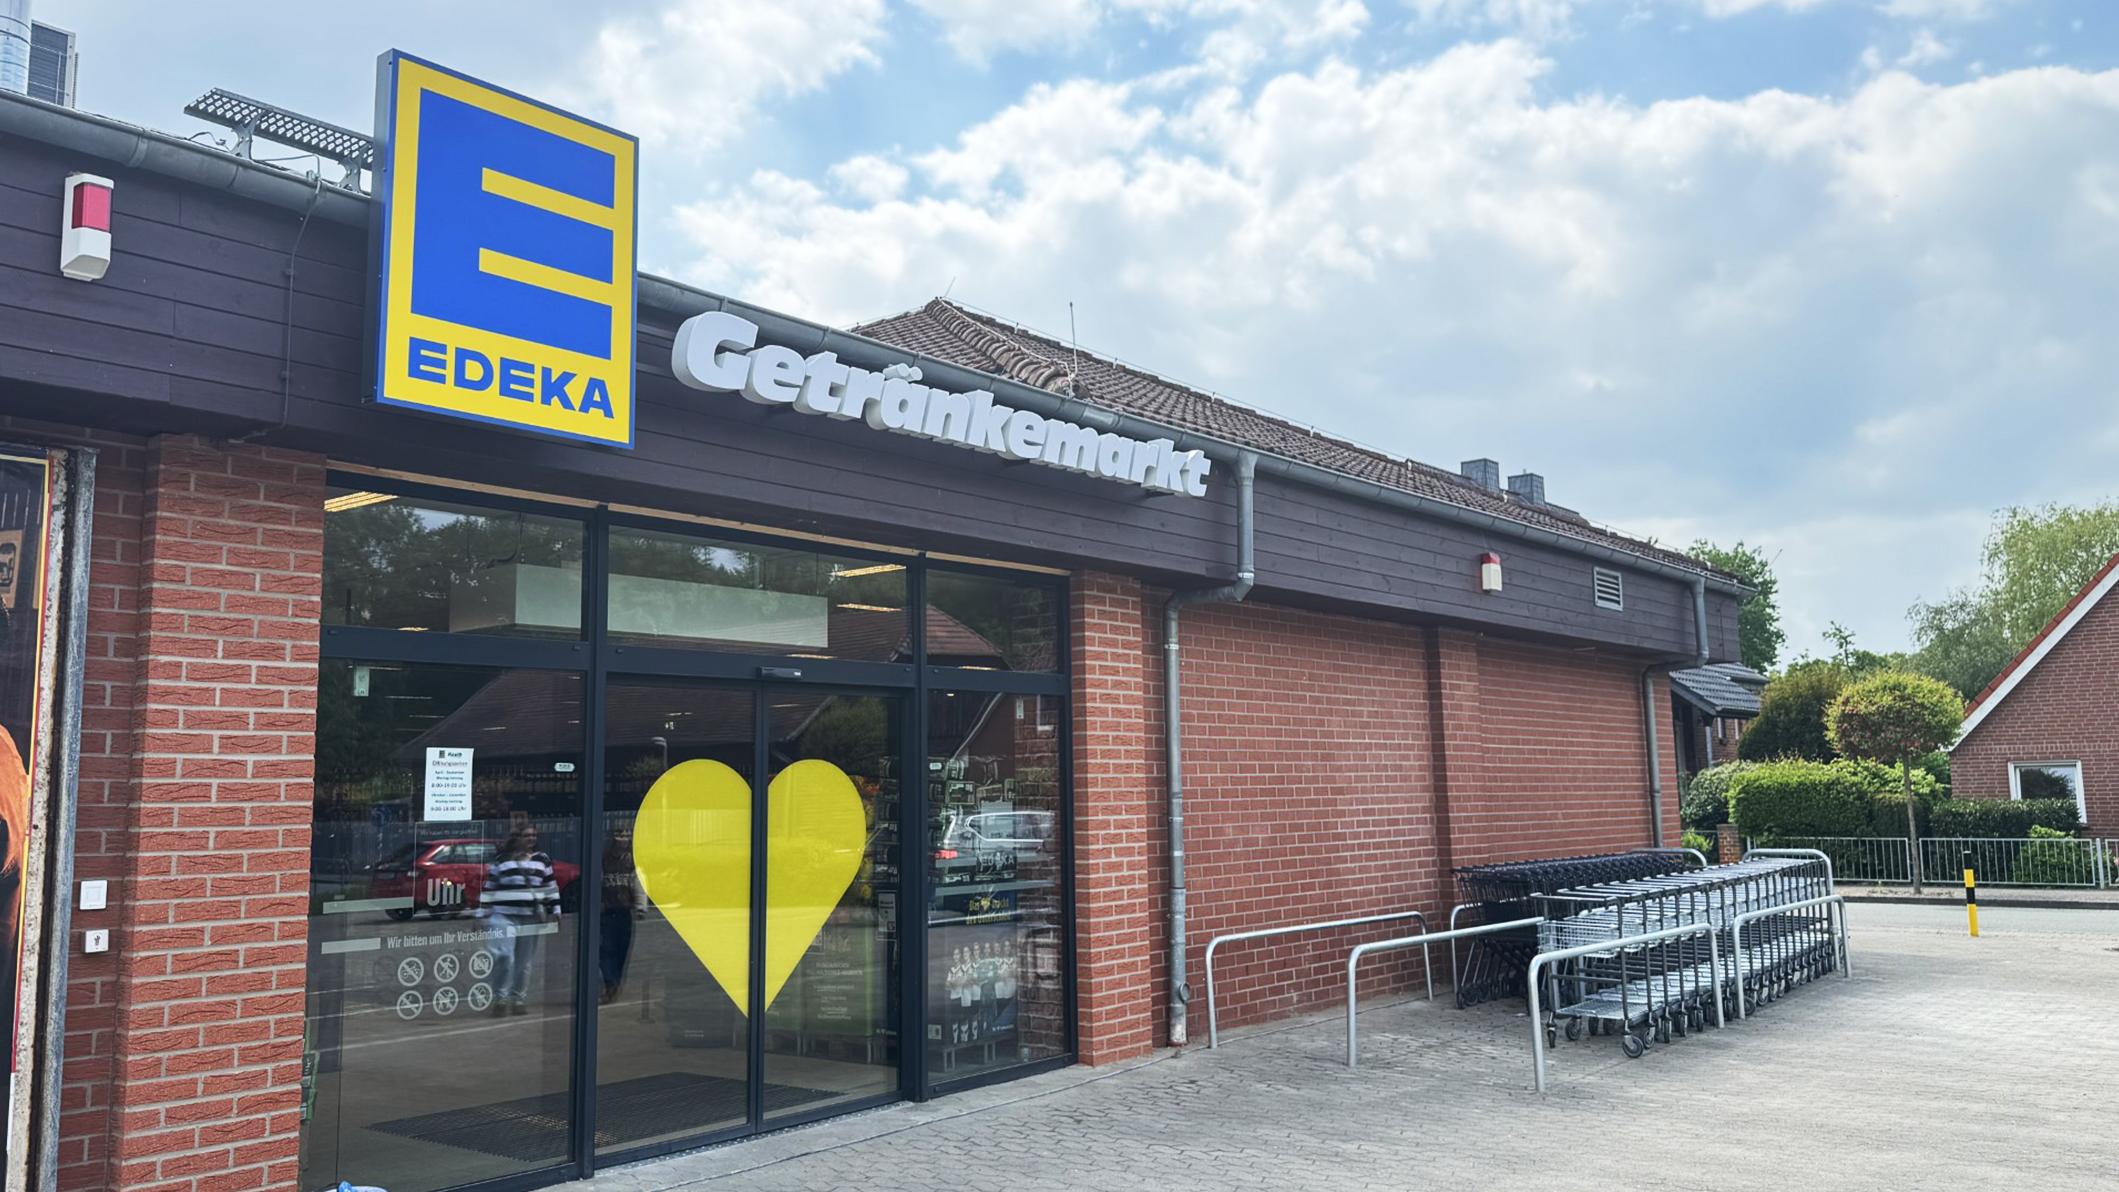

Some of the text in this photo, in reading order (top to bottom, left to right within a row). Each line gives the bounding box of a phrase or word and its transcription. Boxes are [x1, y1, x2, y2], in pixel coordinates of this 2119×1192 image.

[407, 335, 615, 420] EDEKA
[671, 310, 1212, 498] Getränkemarkt
[427, 877, 466, 907] Uhr
[386, 936, 402, 949] Wir
[403, 935, 428, 948] bitten
[428, 935, 443, 945] um
[443, 931, 456, 944] Ihr
